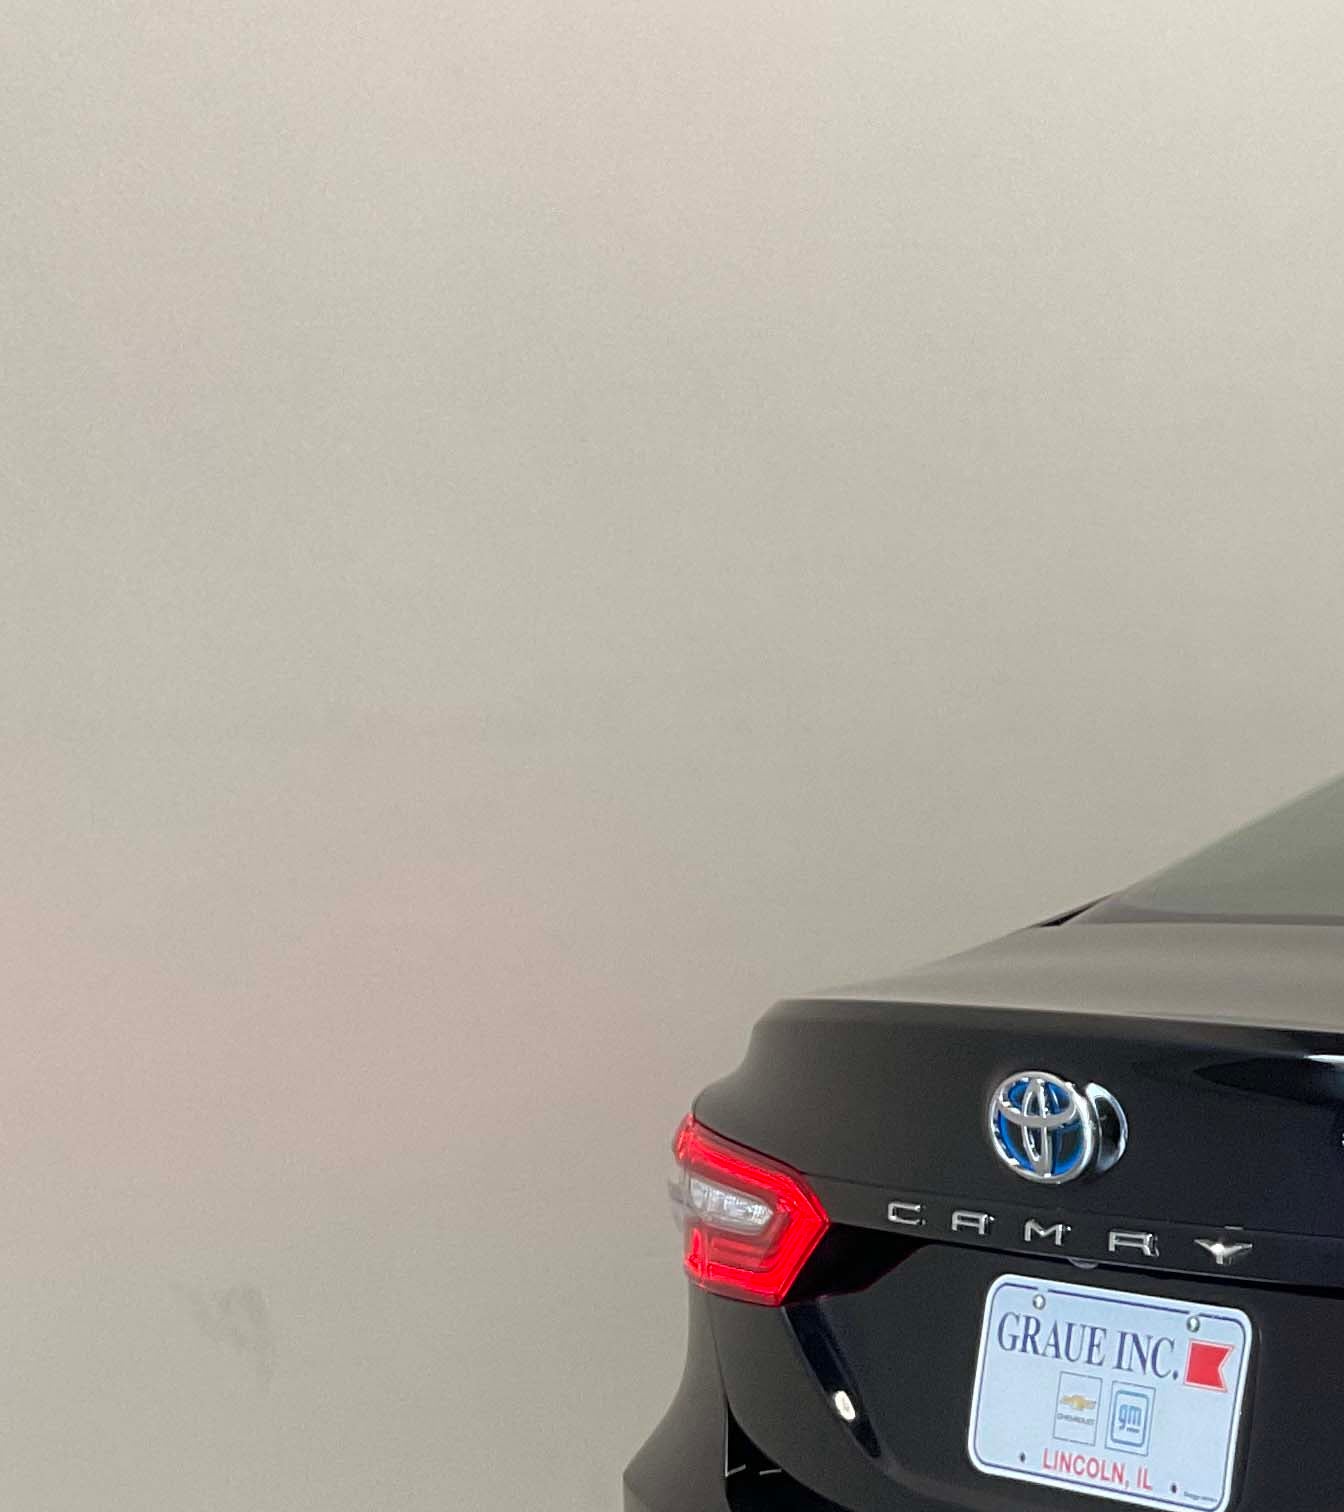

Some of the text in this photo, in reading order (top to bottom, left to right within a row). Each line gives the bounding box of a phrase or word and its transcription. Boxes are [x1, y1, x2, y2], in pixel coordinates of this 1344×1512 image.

[887, 1201, 1253, 1265] CAMRY
[997, 1311, 1179, 1380] GRAUE INC.
[1118, 1404, 1142, 1431] gm
[1042, 1447, 1153, 1491] LINCOLN, IL
